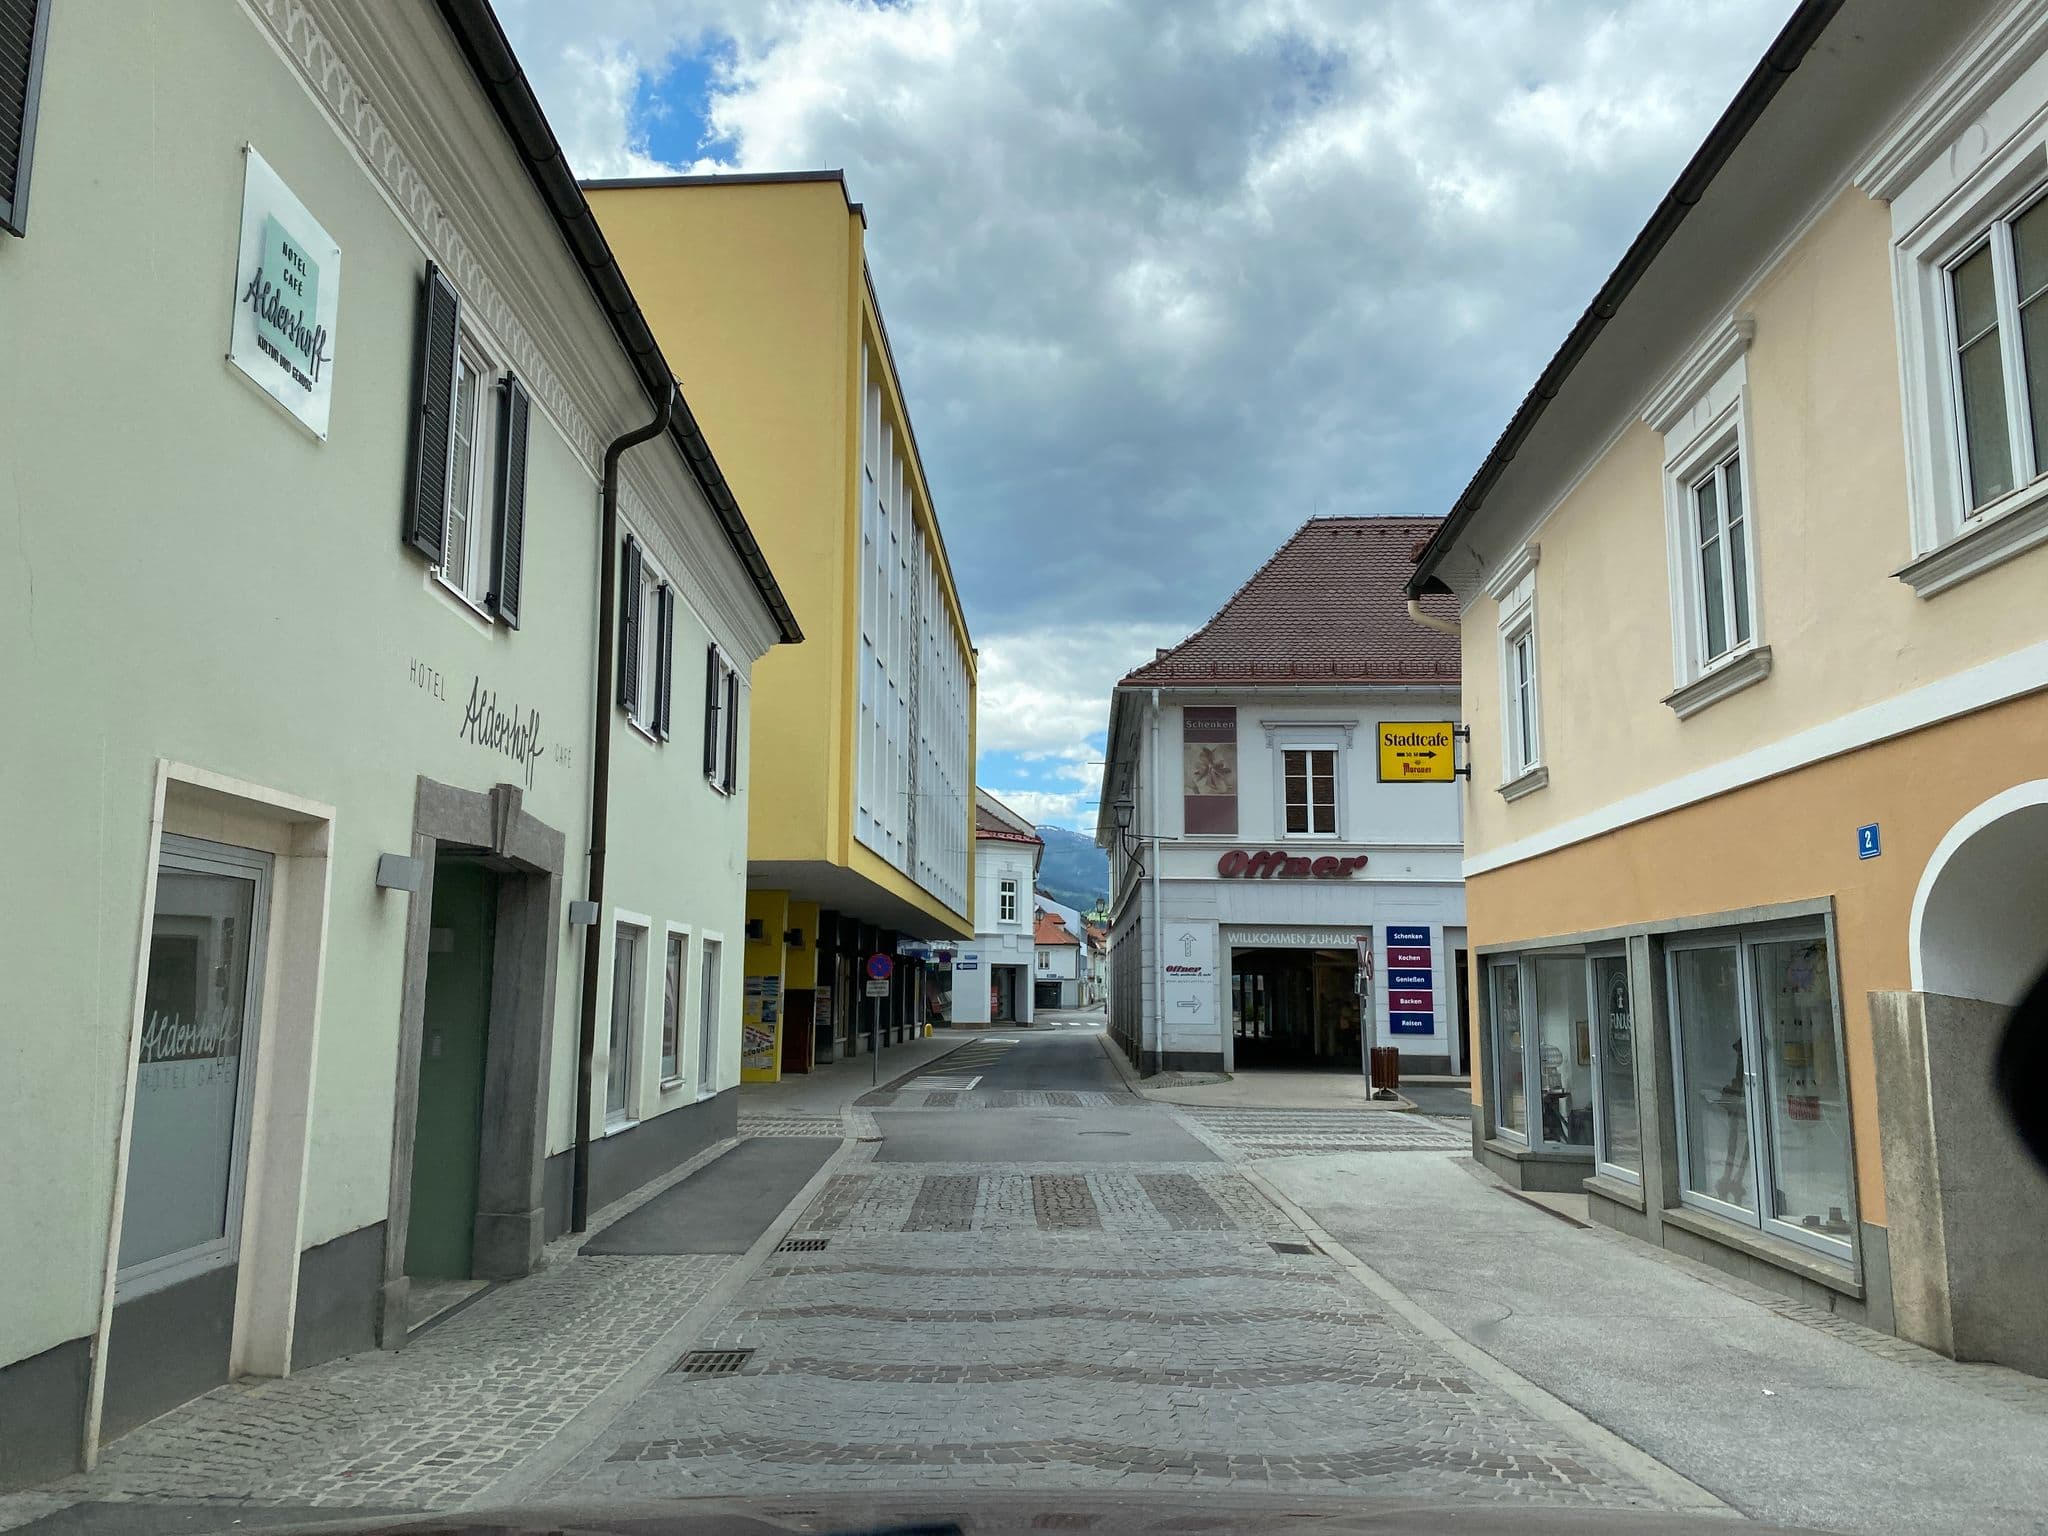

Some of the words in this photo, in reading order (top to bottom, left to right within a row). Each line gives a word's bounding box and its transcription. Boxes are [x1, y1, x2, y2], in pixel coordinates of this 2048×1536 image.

[283, 241, 306, 277] HOTEL
[242, 267, 332, 383] Aldershoff
[258, 334, 279, 363] KULTUR
[280, 354, 292, 373] UND
[292, 366, 312, 392] GENUSS
[410, 657, 445, 702] HOTEL
[460, 676, 544, 791] Aldershoff
[1185, 720, 1234, 729] Schenken
[1384, 732, 1449, 747] Stadtcafe
[1864, 830, 1872, 848] 2
[1217, 849, 1369, 879] Offner
[1227, 931, 1306, 945] WILLKOMMEN
[1310, 933, 1362, 945] ZUHAUS
[1400, 997, 1422, 1005] Backen
